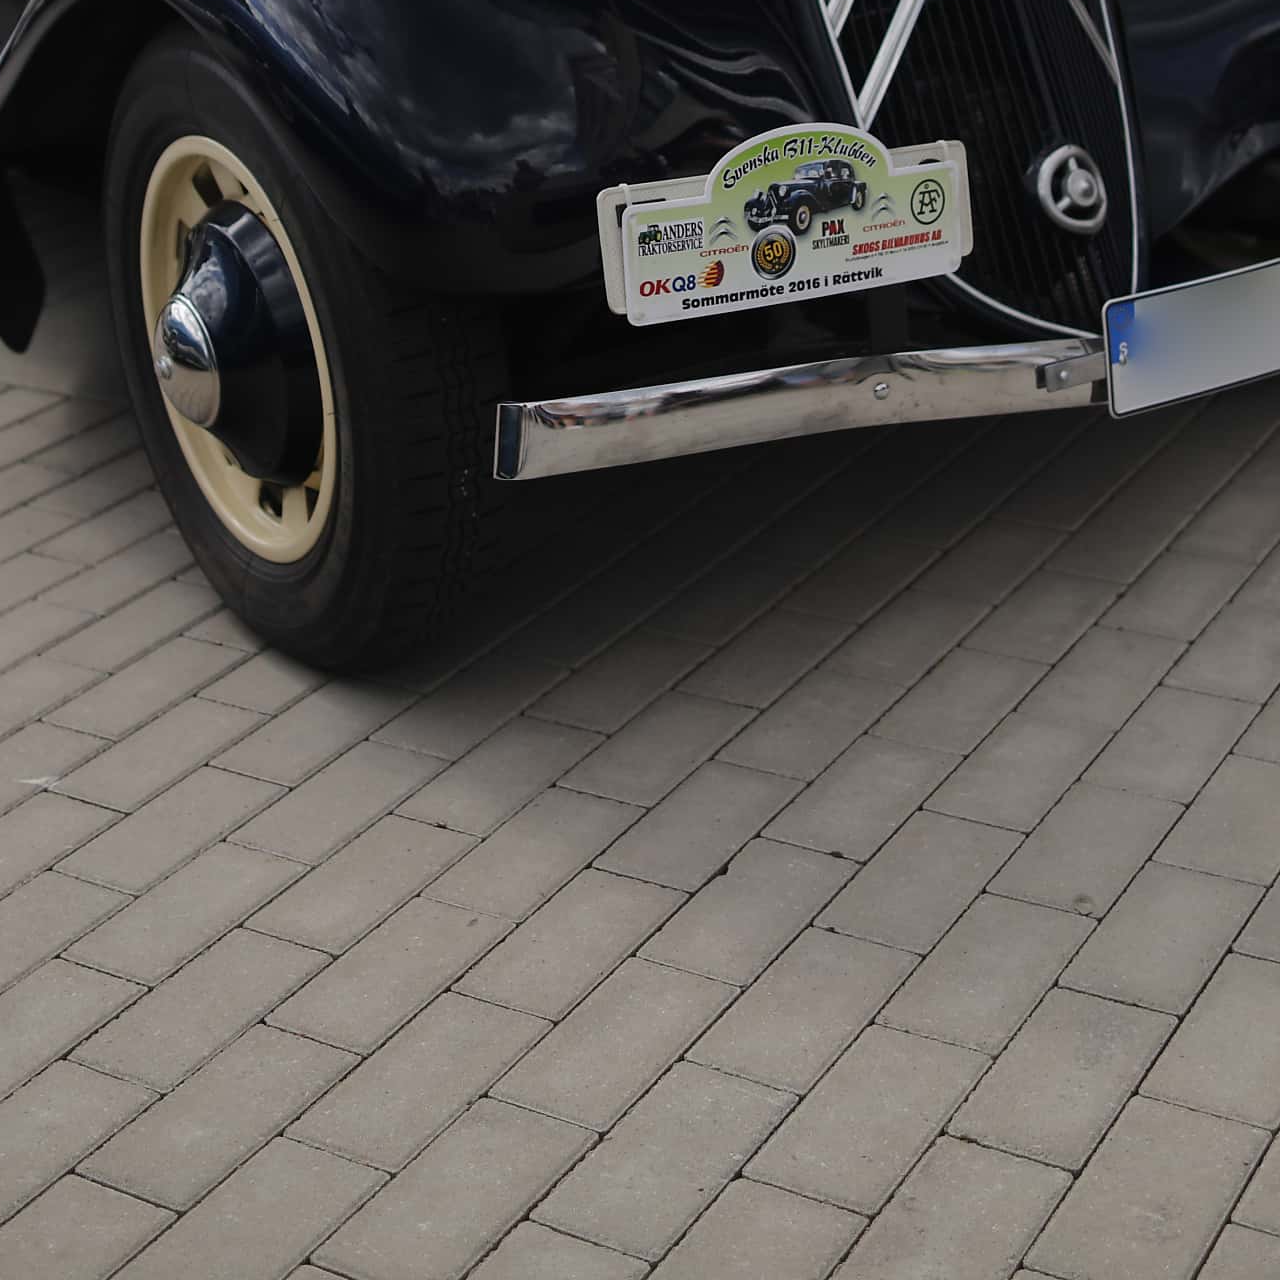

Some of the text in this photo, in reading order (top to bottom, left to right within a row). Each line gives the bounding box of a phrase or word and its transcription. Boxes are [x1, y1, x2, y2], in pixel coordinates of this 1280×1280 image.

[722, 135, 877, 189] Svenska B11-Klubben
[662, 220, 704, 241] ANDERS
[821, 218, 845, 237] PAX
[638, 237, 704, 257] TRAKTORSERVICE
[764, 241, 783, 261] 50
[852, 240, 881, 255] SKOGS
[931, 229, 942, 241] AB
[681, 284, 785, 310] Sommarmöte
[788, 277, 821, 294] 2016
[832, 266, 884, 286] Rättvik
